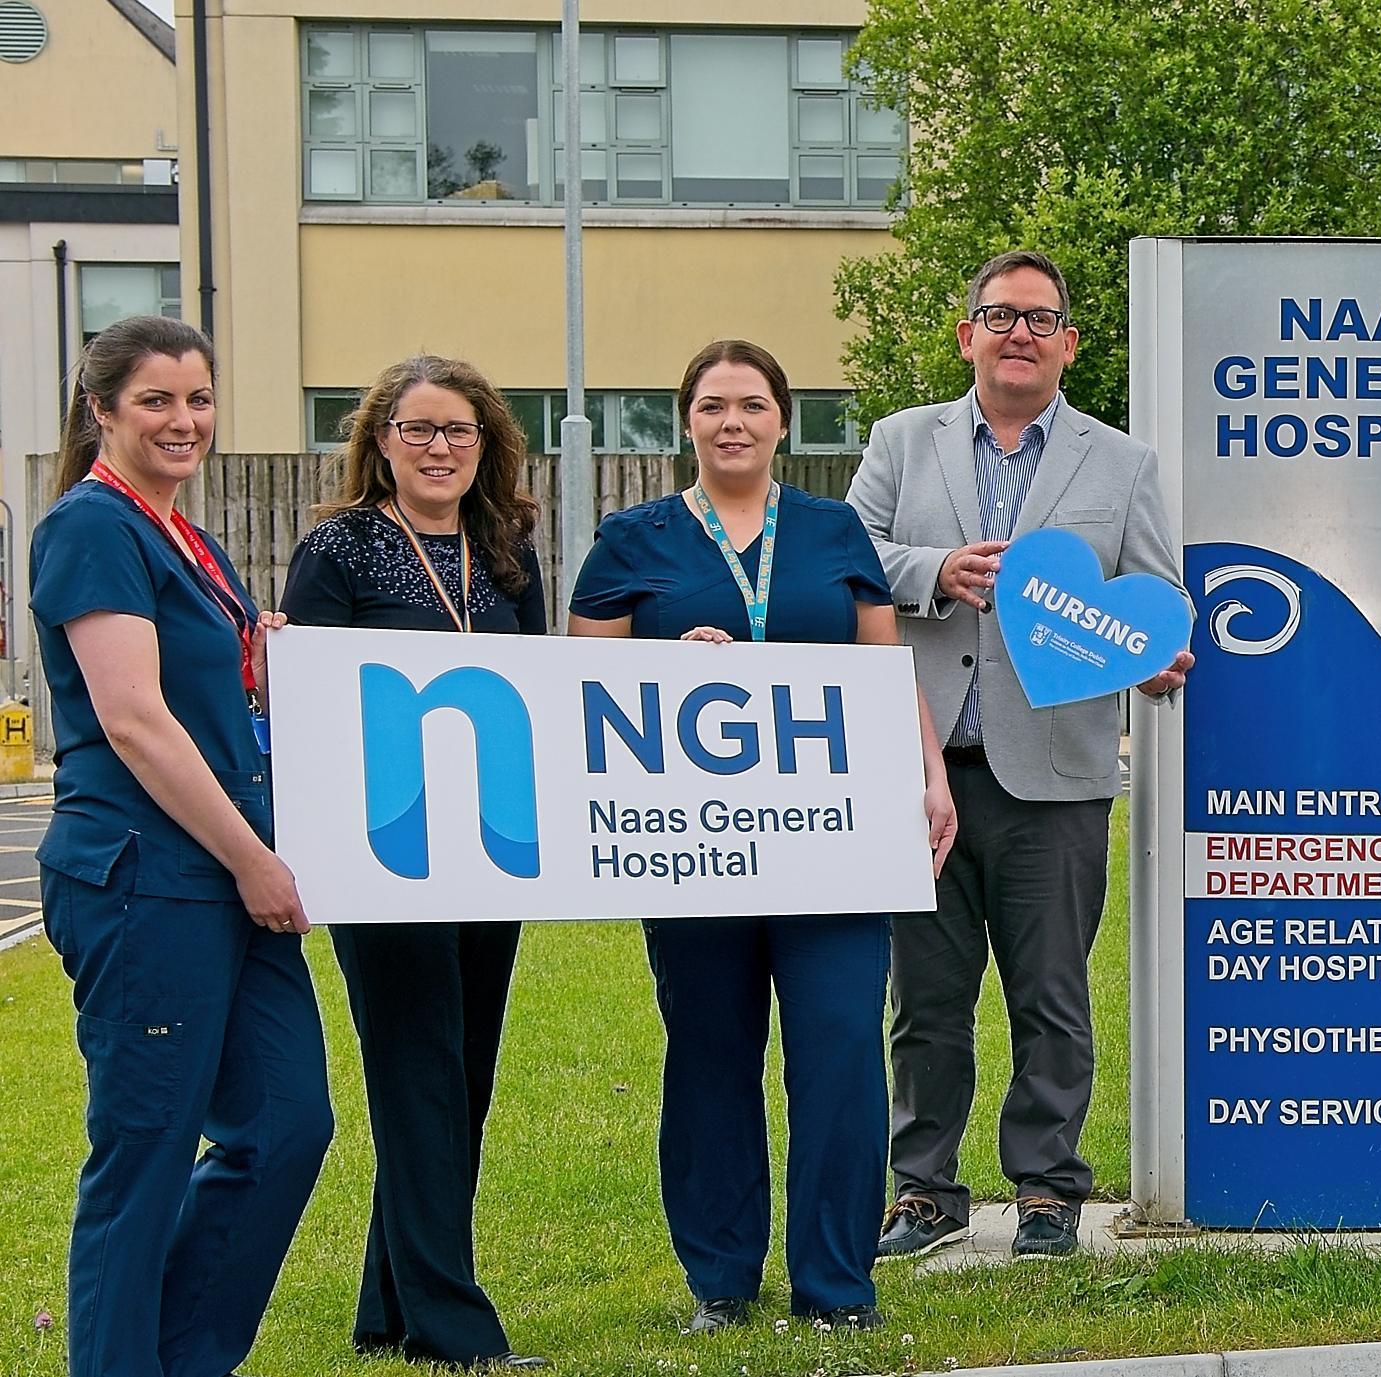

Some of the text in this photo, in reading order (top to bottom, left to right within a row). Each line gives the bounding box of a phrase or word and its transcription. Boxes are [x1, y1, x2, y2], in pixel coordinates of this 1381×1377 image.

[1022, 576, 1149, 655] NURSING
[1053, 633, 1106, 664] Trinity College Dublin
[6, 717, 26, 740] H
[581, 680, 849, 775] NGH
[589, 798, 854, 834] Naas General
[1207, 790, 1285, 816] MAIN
[592, 841, 758, 884] Hospital
[1207, 919, 1273, 945] AGE
[1208, 956, 1270, 980] DAY
[1209, 1099, 1271, 1124] DAY
